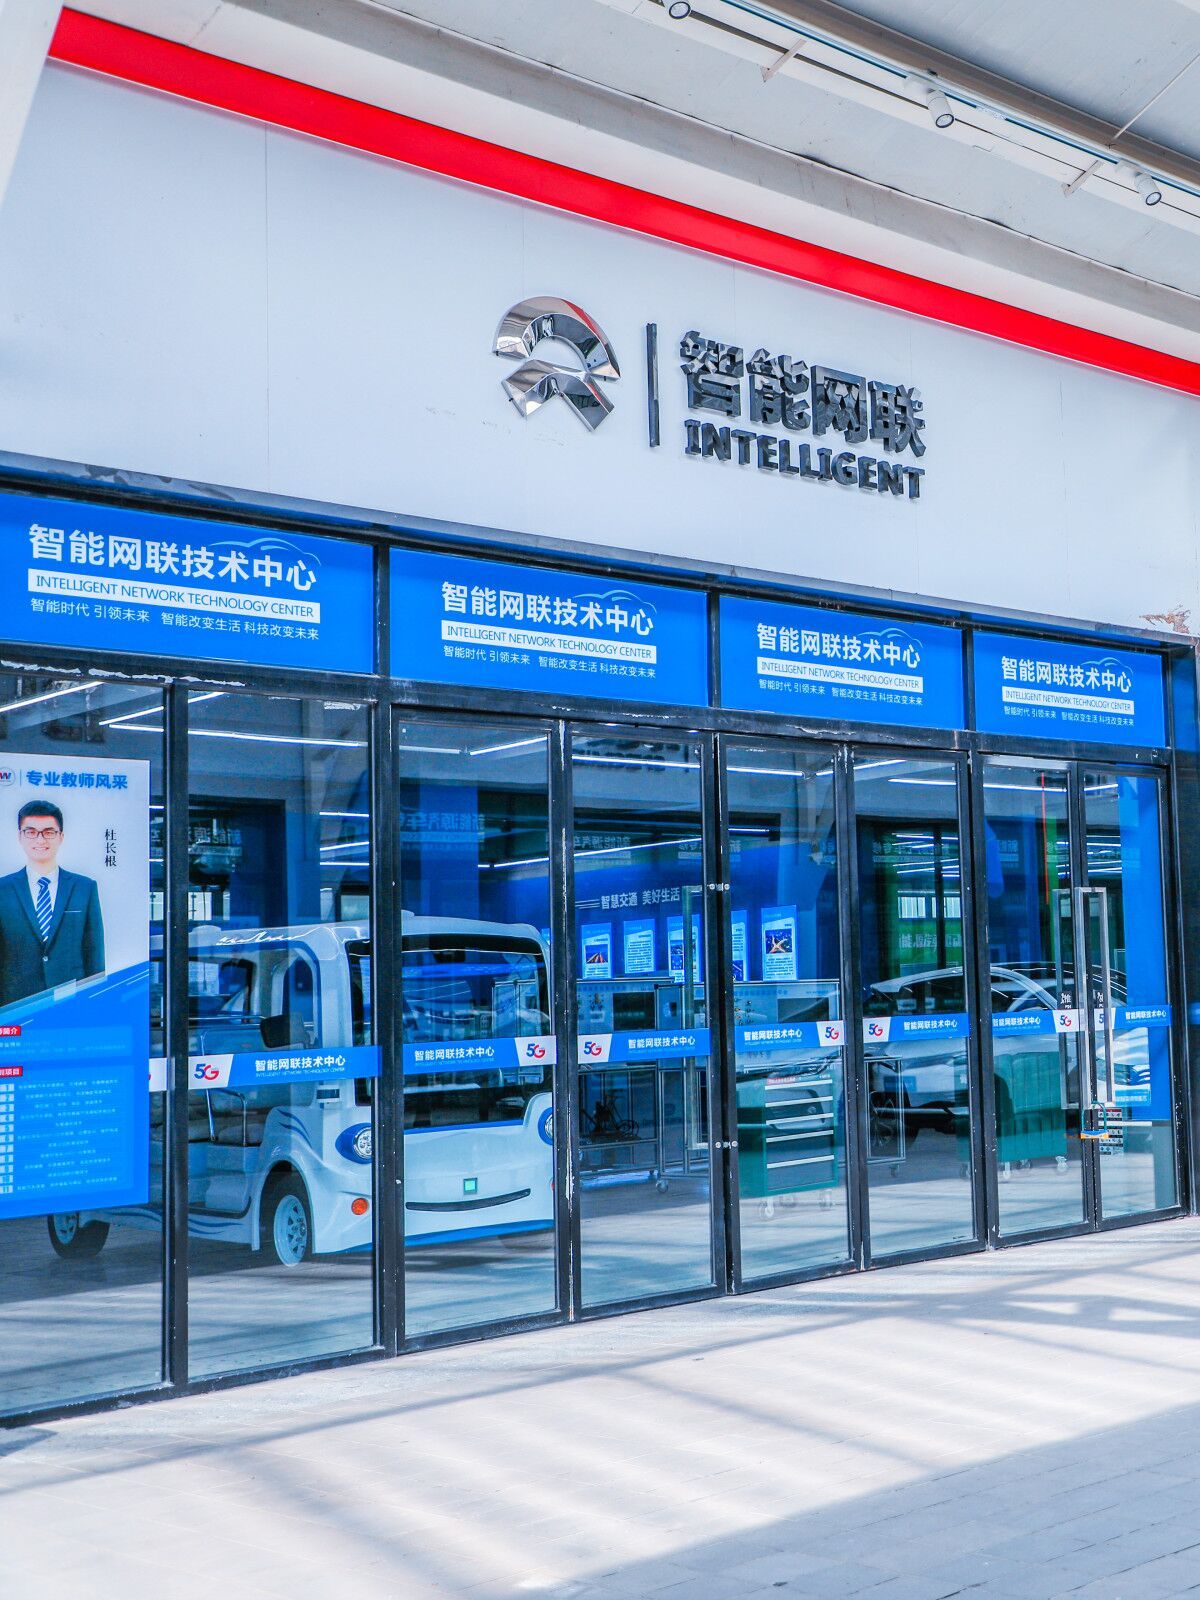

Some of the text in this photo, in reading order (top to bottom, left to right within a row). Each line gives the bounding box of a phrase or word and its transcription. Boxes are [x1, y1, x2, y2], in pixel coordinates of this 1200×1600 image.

[679, 330, 926, 458] 智能网联
[684, 418, 925, 499] INTELLIGENT
[28, 523, 317, 592] 智能网联技术中心
[36, 575, 314, 617] INTELLIGENT NETWORK TECHNOLOGY CENTER
[31, 598, 320, 640] 智能时代 引领未来 智能改变生活 科技改变未来
[441, 581, 654, 636] 智能网联技术中心
[447, 625, 652, 659] INTELLIGENT NETWORK TECHNOLOGY CENTER
[757, 623, 921, 669] 智能网联技术中心
[443, 645, 656, 679] 智能时代 引领未来 智能改变生活 科技改变未来
[761, 661, 920, 688] INTELLIGENT NETWORK TECHNOLOGY CENTER
[1001, 656, 1132, 693] 智能网联技术中心
[1005, 690, 1131, 711] INTELLIGENT NETWORK TECHNOLOGY CENTER
[26, 770, 128, 789] 专业教师风采
[105, 828, 117, 867] 杜长根
[601, 888, 680, 909] 智慧交通 美好生活
[904, 1019, 958, 1031] 智能网联技术中心
[1060, 1015, 1072, 1027] 5G
[1126, 1010, 1167, 1021] 智能网联技术中心
[744, 1029, 802, 1041] 智能网联技术中心
[825, 1026, 839, 1040] 5G
[868, 1023, 883, 1037] 5G
[526, 1043, 545, 1059] 5G
[584, 1041, 602, 1056] 5G
[628, 1035, 695, 1049] 智能网联技术中心
[255, 1055, 346, 1072] 智能网联技术中心
[414, 1046, 495, 1061] 智能网联技术中心
[194, 1064, 219, 1080] 5G
